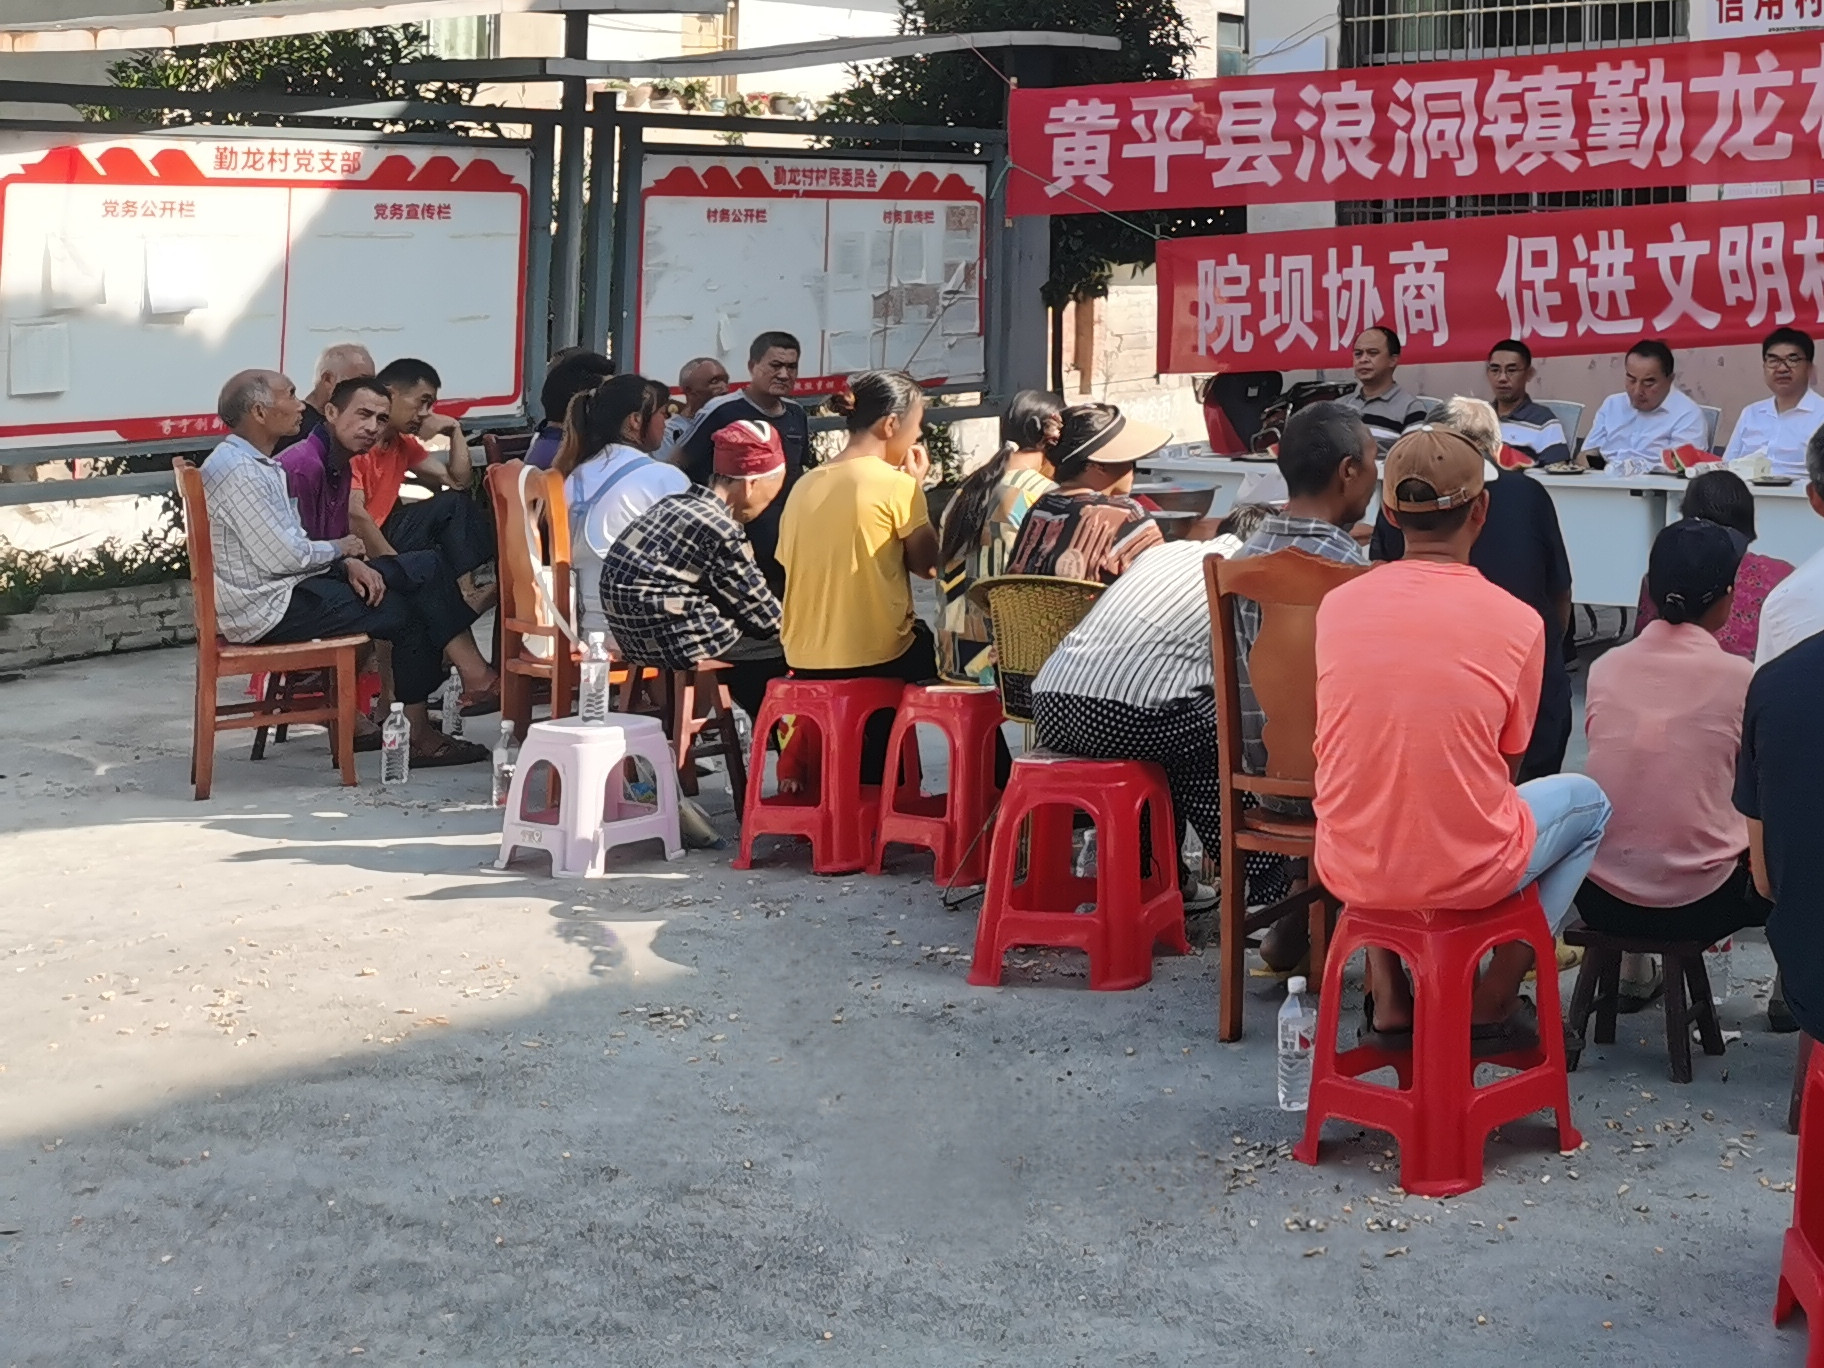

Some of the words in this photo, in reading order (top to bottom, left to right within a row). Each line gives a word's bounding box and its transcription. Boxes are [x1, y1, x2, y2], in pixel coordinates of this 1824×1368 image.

[213, 145, 362, 175] 勤龙村党支部
[773, 164, 878, 188] 勤龙村村民委员会
[101, 199, 196, 220] 党务公开栏
[373, 202, 452, 222] 党务宣传栏
[706, 207, 768, 224] 村务公开栏
[882, 209, 936, 225] 村务宣传栏
[1197, 240, 1450, 357] 院坝协商
